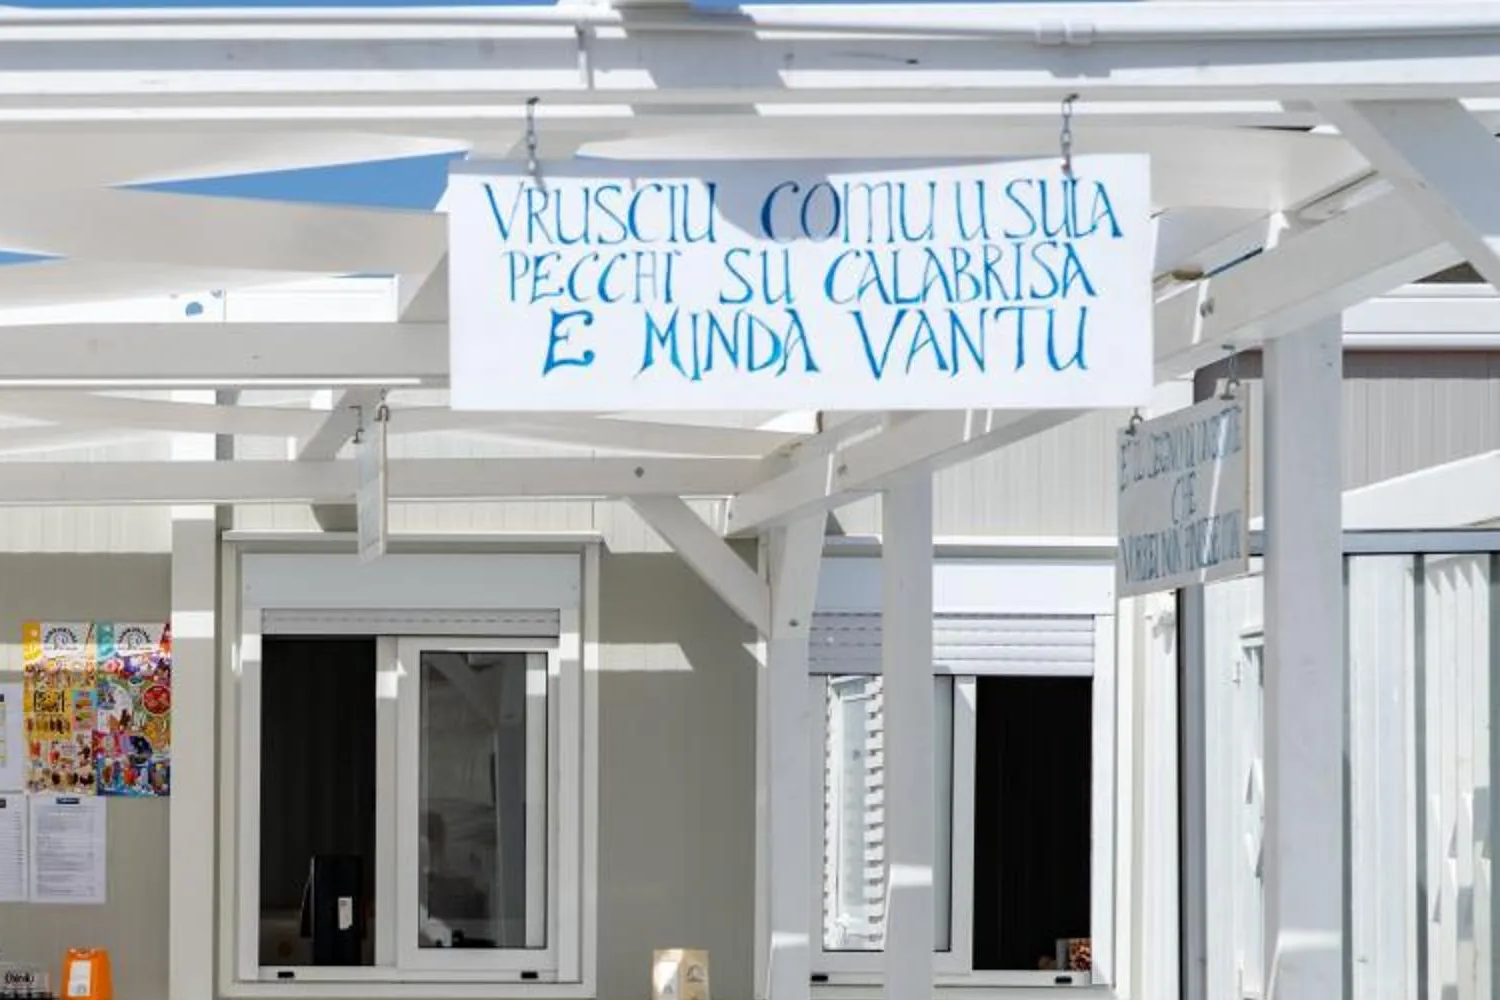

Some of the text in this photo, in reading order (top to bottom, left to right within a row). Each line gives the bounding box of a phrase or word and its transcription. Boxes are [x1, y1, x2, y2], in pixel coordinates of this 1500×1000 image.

[482, 180, 717, 246] VRUSCIU
[759, 180, 937, 244] COMU
[719, 247, 796, 304] SU
[824, 240, 1099, 304] CALABRISA
[541, 305, 1089, 381] E MINDA VANTU
